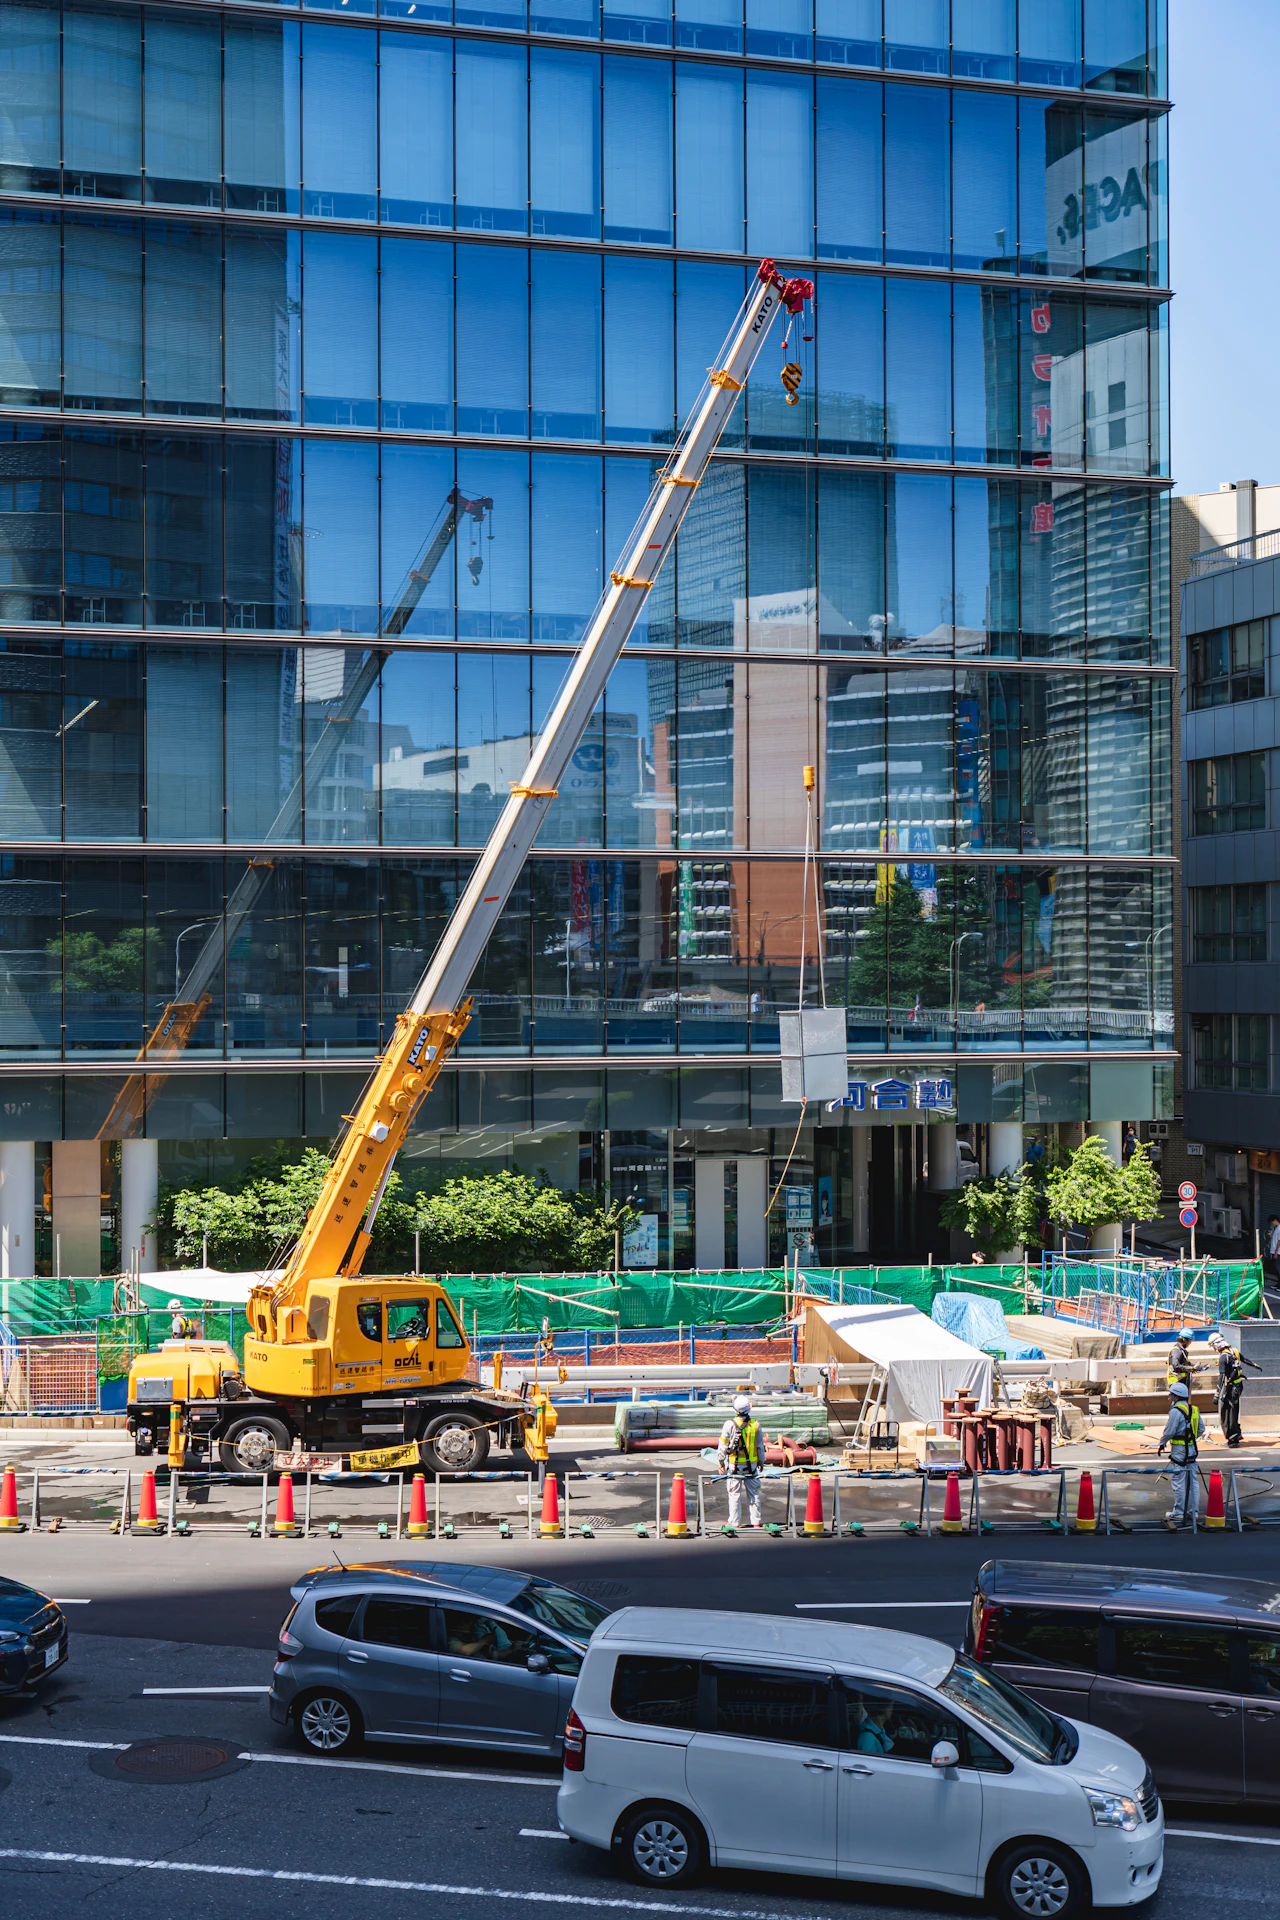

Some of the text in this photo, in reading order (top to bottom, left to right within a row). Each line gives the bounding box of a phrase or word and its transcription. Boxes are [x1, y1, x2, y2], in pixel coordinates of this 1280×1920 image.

[752, 296, 773, 334] KATO
[408, 1029, 429, 1064] KATO
[1183, 1187, 1193, 1196] 30
[249, 1351, 268, 1362] KATO
[282, 1455, 334, 1466] 立入禁止
